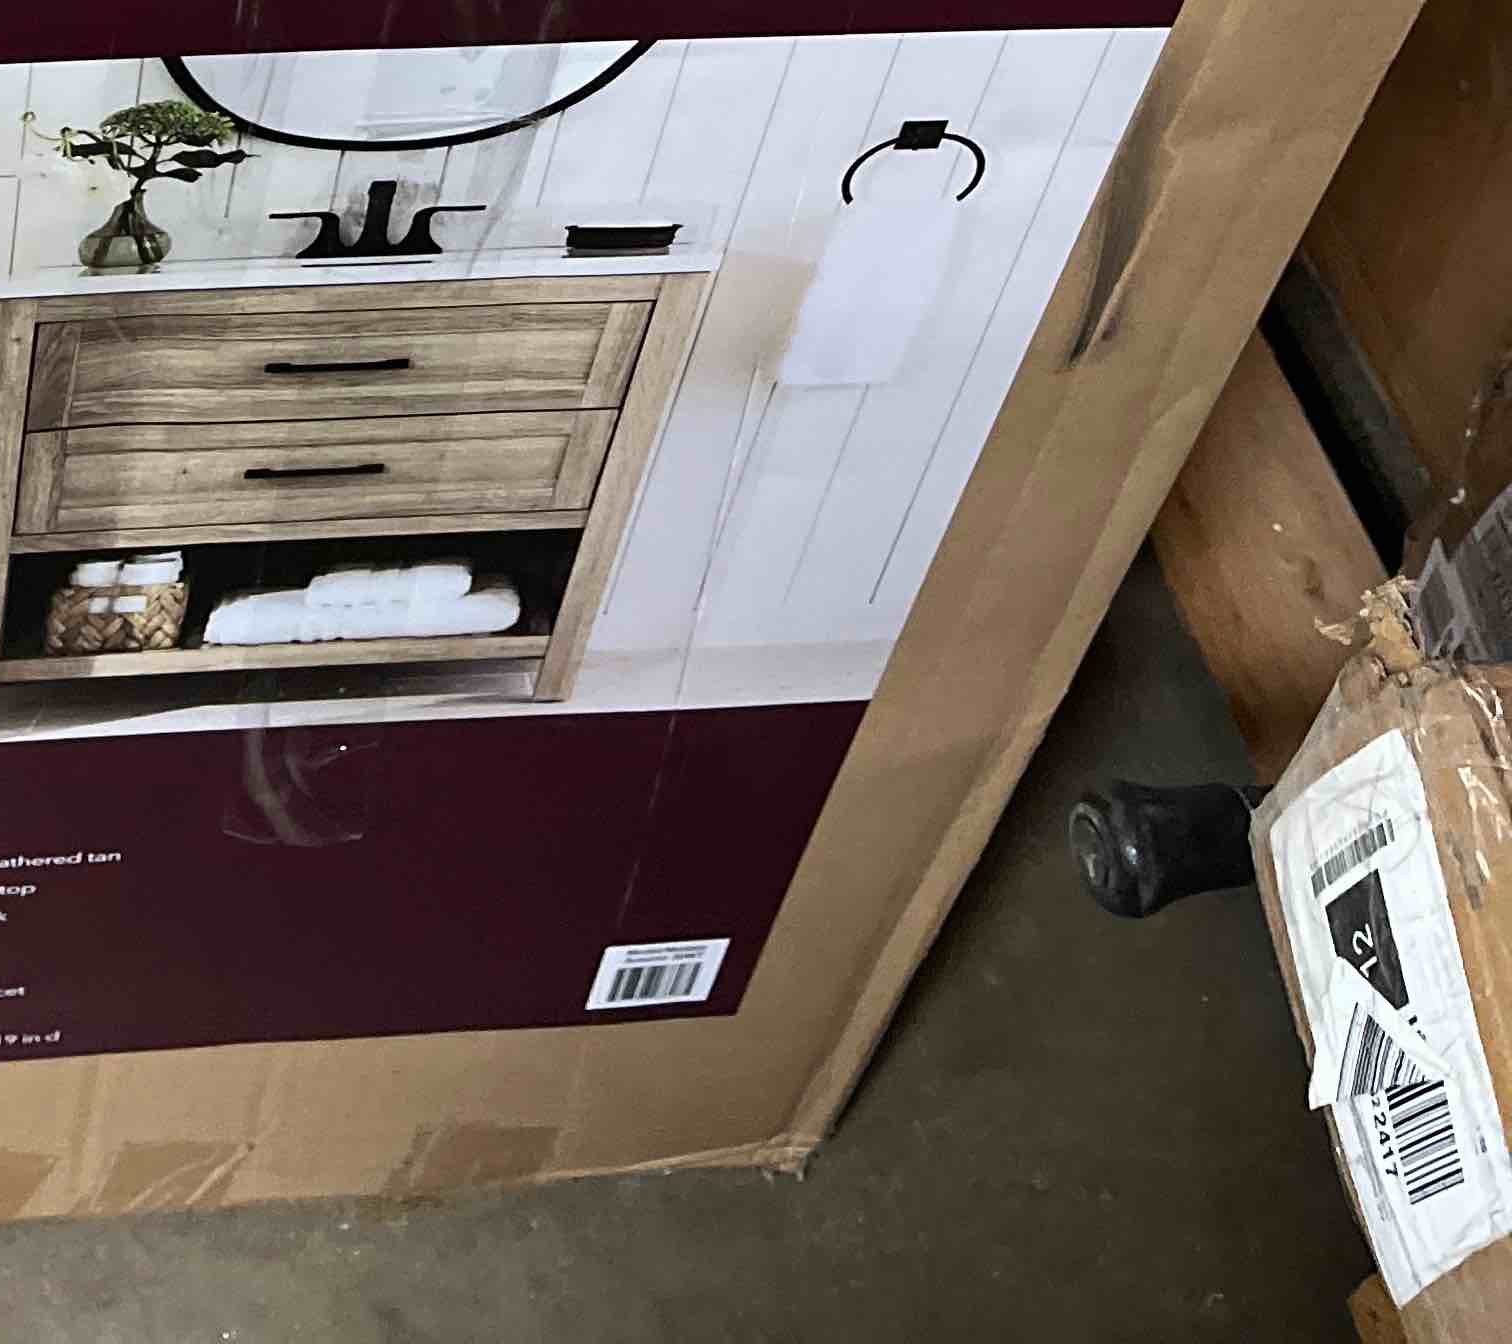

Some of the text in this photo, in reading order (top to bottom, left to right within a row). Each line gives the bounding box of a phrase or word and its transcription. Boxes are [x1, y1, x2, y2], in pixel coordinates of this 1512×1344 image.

[87, 851, 121, 863] tan
[0, 884, 38, 897] top
[44, 1030, 61, 1042] d
